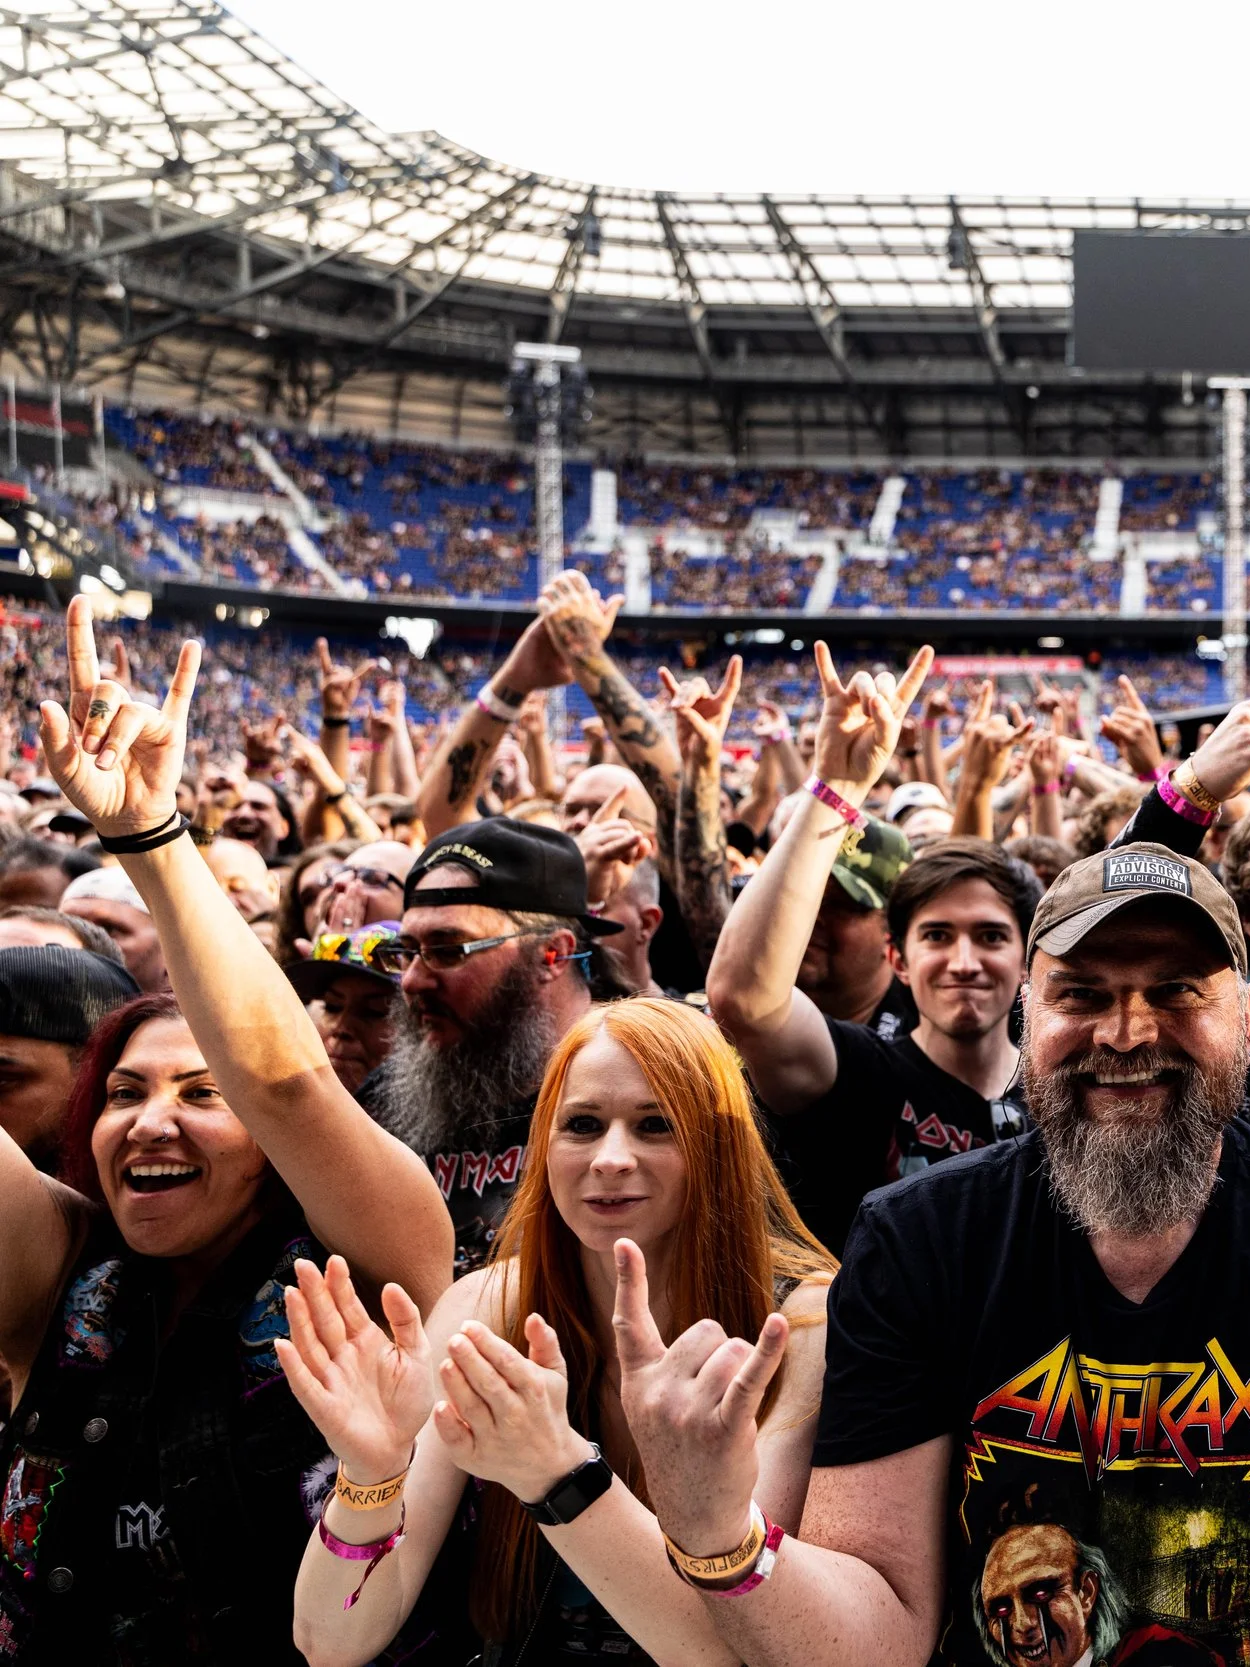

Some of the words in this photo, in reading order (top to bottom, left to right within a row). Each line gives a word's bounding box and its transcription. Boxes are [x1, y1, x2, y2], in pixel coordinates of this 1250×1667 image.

[1114, 861, 1182, 880] ADVISORY
[1114, 874, 1149, 883] EXPLICIT
[1151, 876, 1183, 890] CONTENT
[336, 1478, 404, 1505] BARRIER
